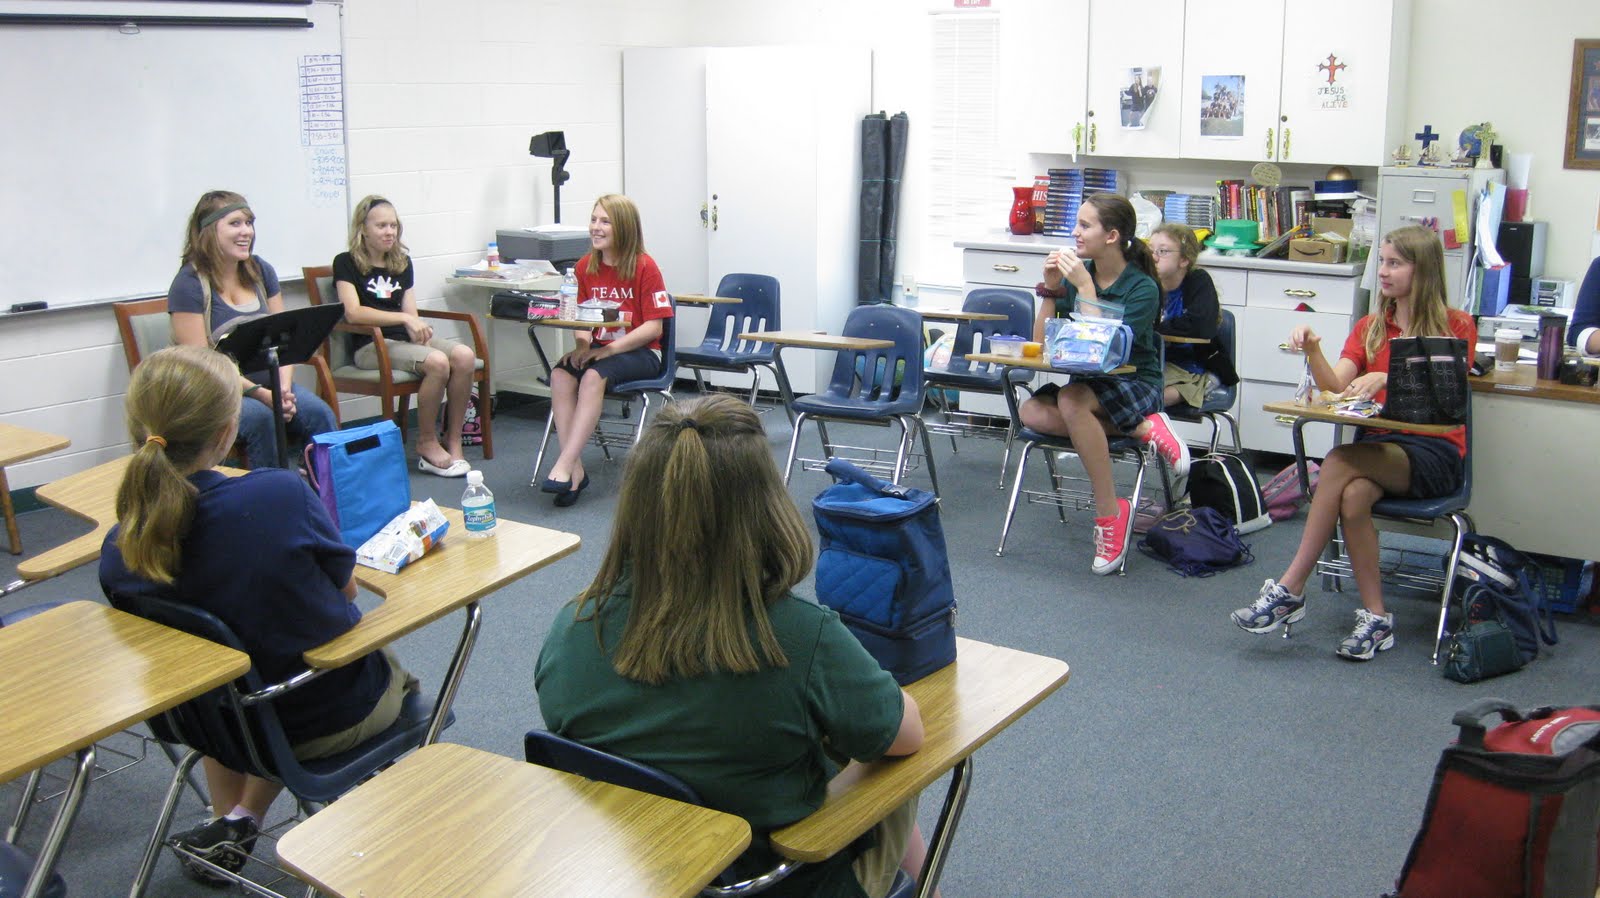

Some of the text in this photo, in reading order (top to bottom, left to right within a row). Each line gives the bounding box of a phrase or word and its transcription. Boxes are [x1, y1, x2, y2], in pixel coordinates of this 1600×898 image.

[1317, 86, 1345, 95] JESUS
[1321, 101, 1348, 109] ALIVE
[366, 275, 402, 293] ITALY
[591, 286, 634, 299] TEAM
